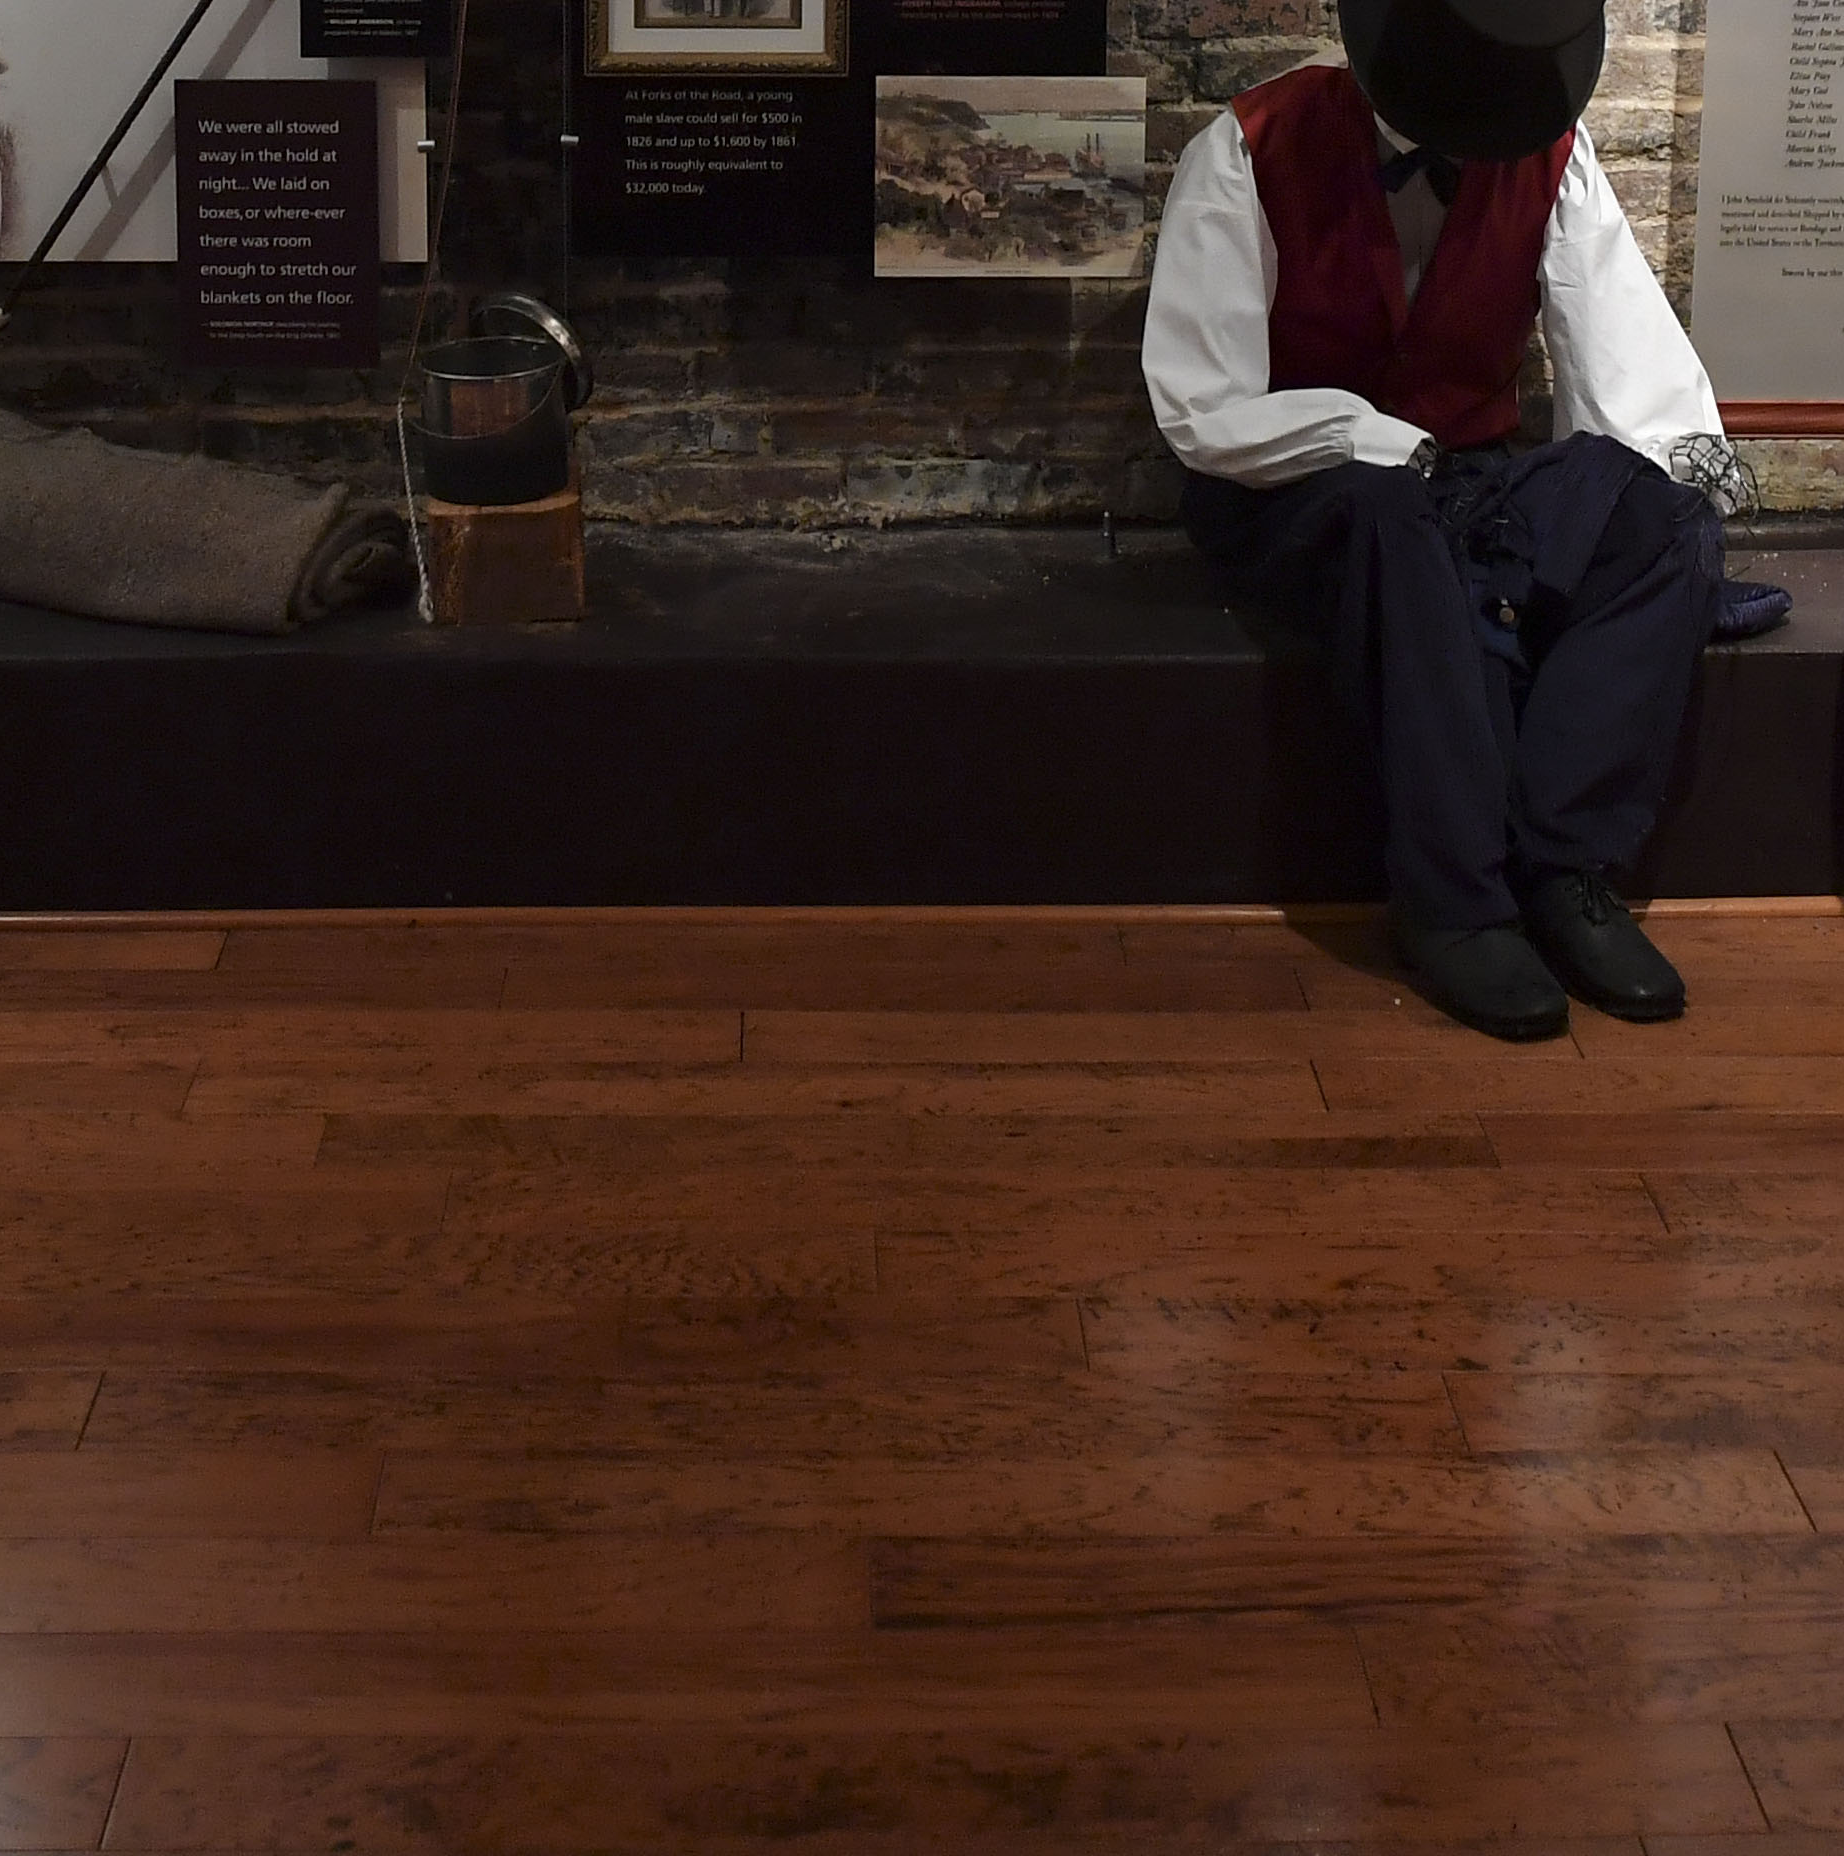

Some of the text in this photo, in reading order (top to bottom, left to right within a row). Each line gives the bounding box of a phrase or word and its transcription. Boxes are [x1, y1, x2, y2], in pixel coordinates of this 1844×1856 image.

[625, 112, 802, 124] male slave could sell for $500 in
[198, 120, 339, 134] We were all stowed
[627, 137, 652, 146] 1826
[656, 136, 677, 146] and
[681, 139, 695, 147] up
[699, 138, 710, 146] to
[714, 136, 750, 147] $1,600
[754, 136, 766, 148] by
[199, 148, 337, 165] away in the hold at
[252, 177, 276, 190] We
[281, 177, 306, 190] laid
[311, 180, 329, 190] on
[264, 205, 345, 219] where-ever
[200, 234, 311, 247] there was room
[201, 262, 356, 279] enough to stretch our
[201, 290, 353, 304] blankets on the floor.
